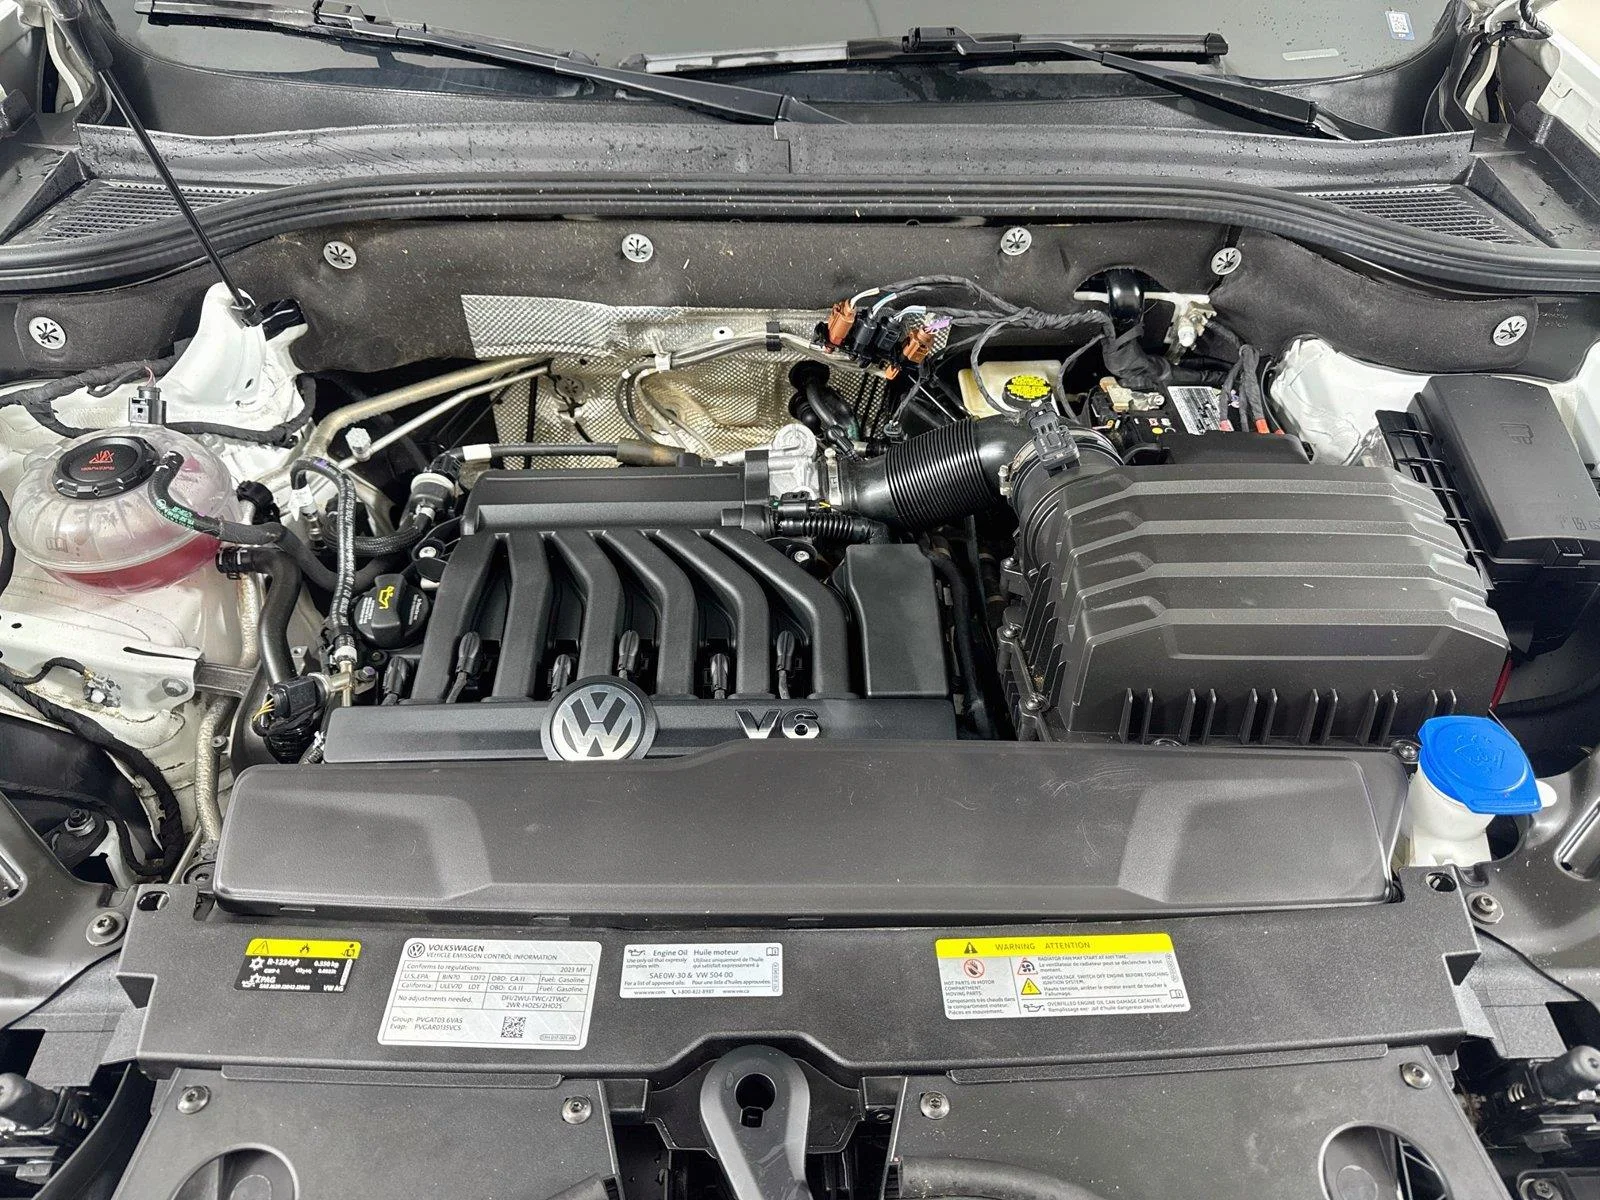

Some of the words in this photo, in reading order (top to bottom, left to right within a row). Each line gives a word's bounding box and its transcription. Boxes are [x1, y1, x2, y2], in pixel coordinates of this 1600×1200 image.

[735, 708, 820, 739] V6
[428, 944, 485, 952] VOLKSWAGEN
[995, 943, 1036, 951] WARNING
[267, 958, 300, 967] R-1234yf
[408, 995, 447, 1003] adjustments
